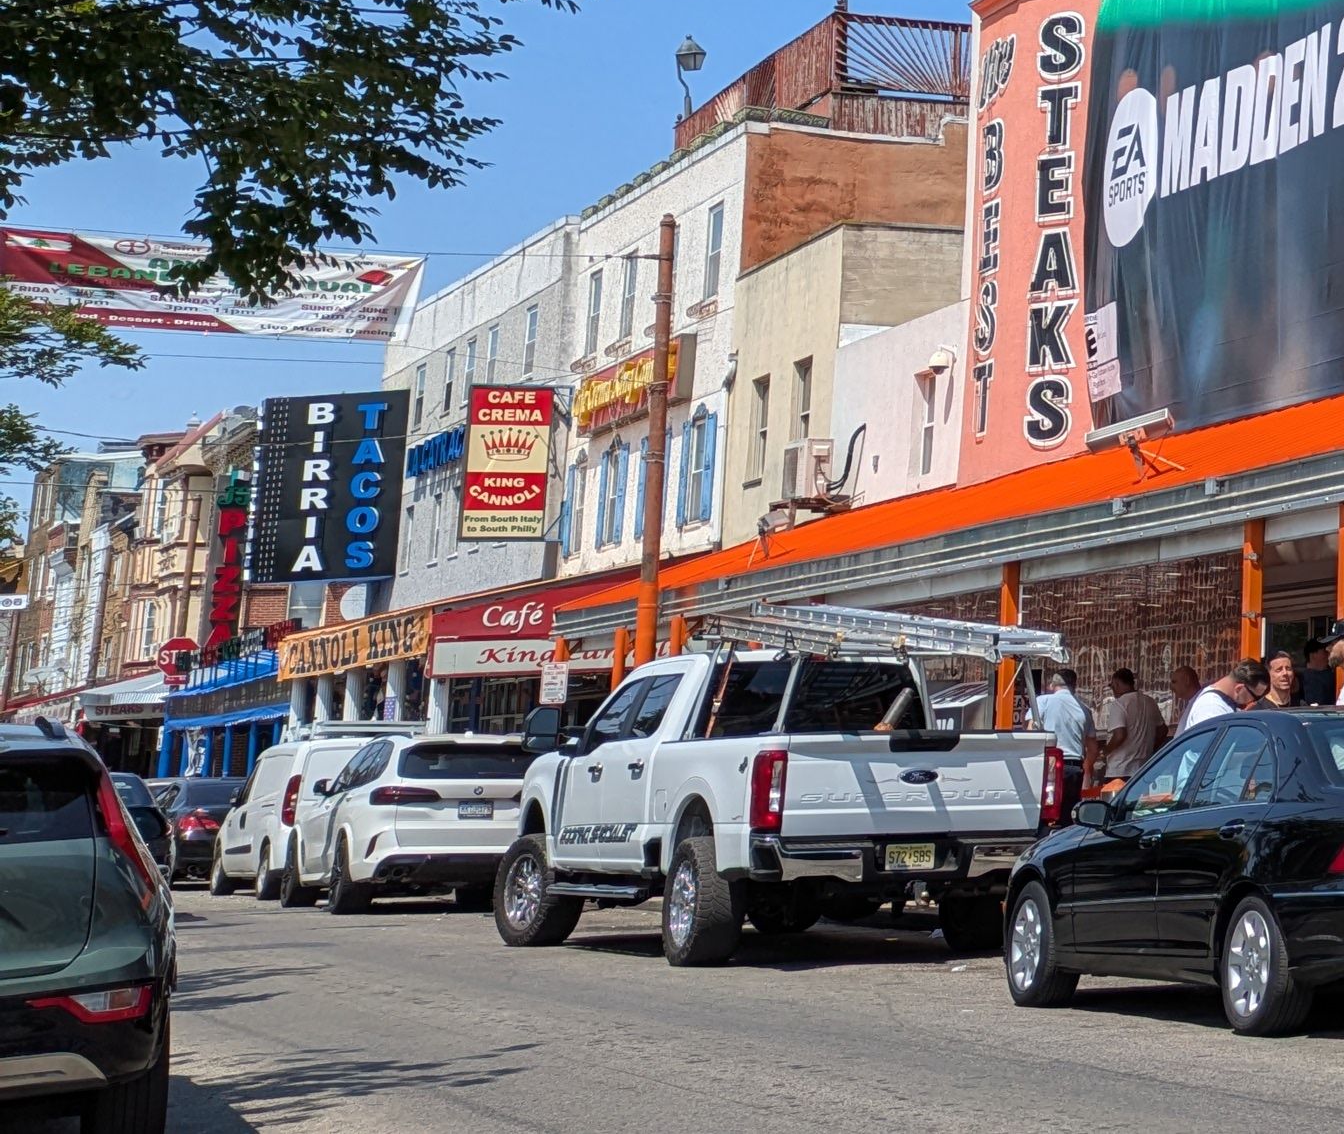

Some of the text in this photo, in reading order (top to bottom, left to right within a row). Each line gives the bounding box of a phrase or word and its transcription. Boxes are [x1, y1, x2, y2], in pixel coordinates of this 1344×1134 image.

[1160, 22, 1332, 199] MADDEN
[1111, 121, 1146, 180] EA
[1108, 171, 1146, 207] SPORTS
[1024, 11, 1085, 450] STEAKS
[973, 118, 1005, 443] BEST
[108, 315, 164, 325] Dessert
[173, 319, 219, 327] Drinks
[488, 391, 536, 404] CAFE
[478, 409, 543, 422] CREMA
[291, 403, 335, 572] BIRRIA
[346, 402, 388, 570] TACOS
[484, 477, 526, 488] KING
[468, 485, 541, 506] CANNOLI
[464, 515, 543, 525] From South Italy
[480, 525, 508, 533] South
[511, 525, 537, 534] Philly
[482, 601, 545, 634] Café
[289, 629, 360, 675] CANNOLI
[366, 615, 415, 661] KING
[95, 705, 144, 716] STEAKS
[801, 788, 1028, 804] SUPER DUTY
[889, 850, 907, 864] S72
